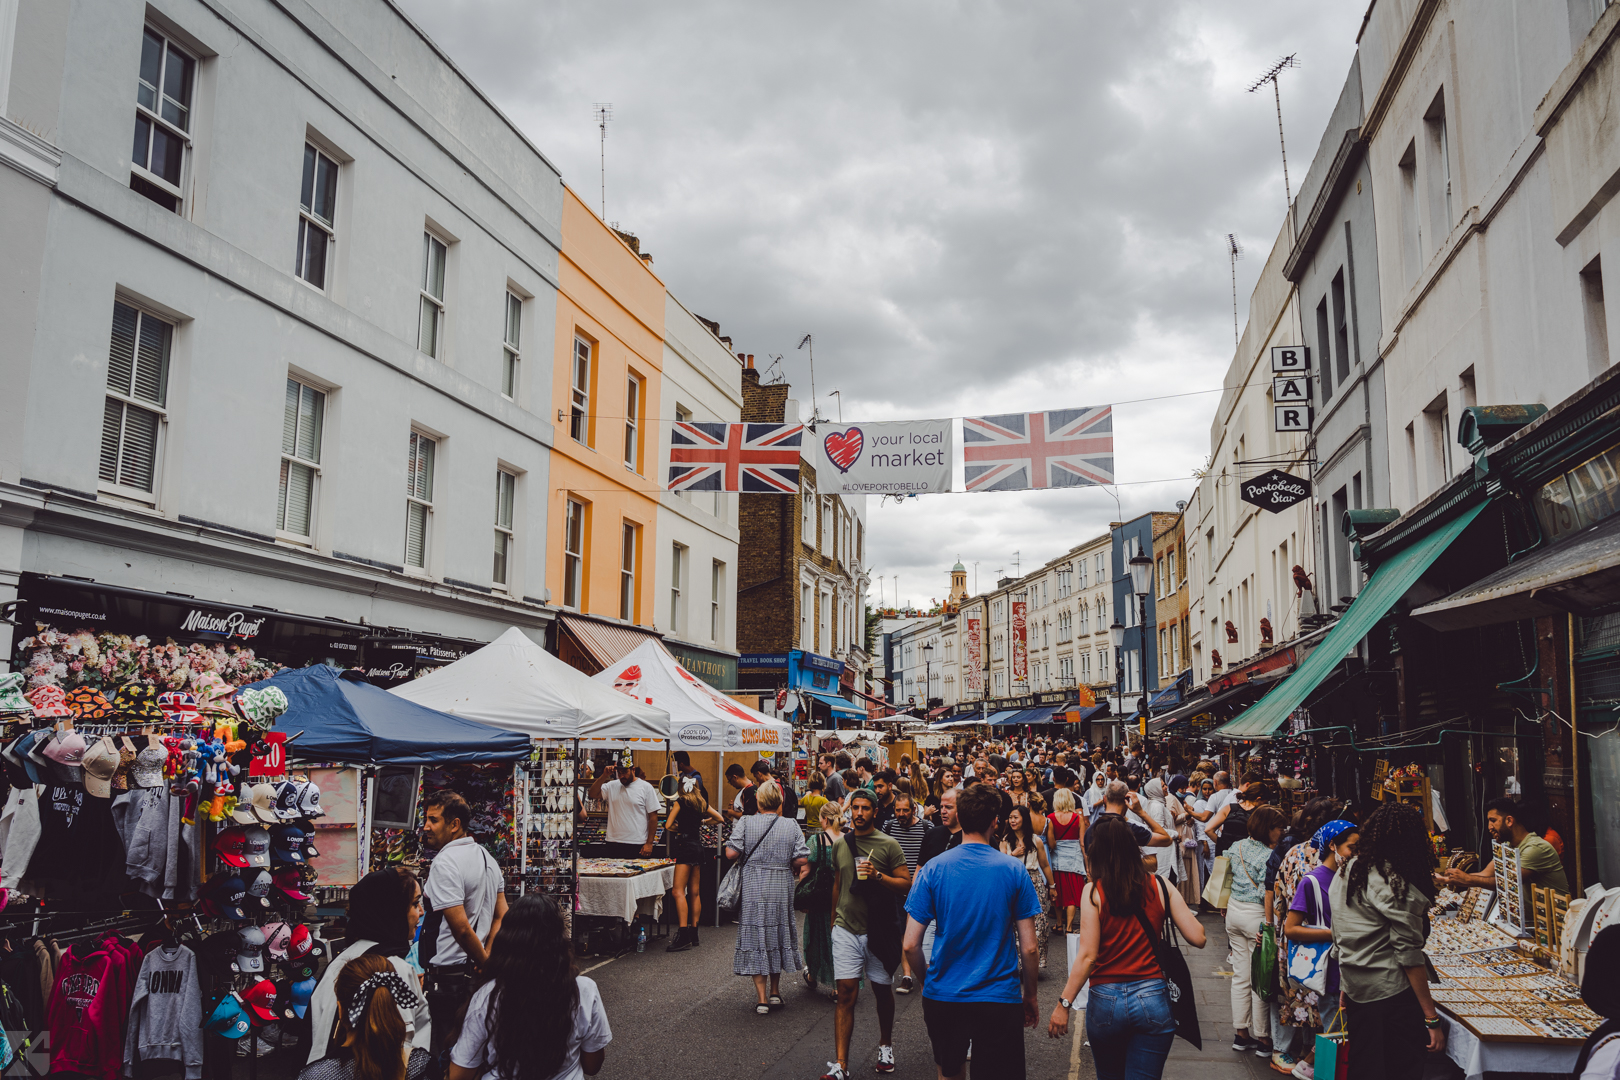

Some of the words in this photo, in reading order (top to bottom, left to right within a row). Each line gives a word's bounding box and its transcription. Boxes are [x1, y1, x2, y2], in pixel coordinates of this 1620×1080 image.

[1281, 350, 1302, 427] BAR
[871, 434, 904, 448] your
[909, 431, 943, 444] local
[871, 449, 944, 467] market
[842, 482, 928, 491] #LOVEPORTOBELLO
[1246, 479, 1305, 498] Portobello
[1271, 491, 1296, 503] Star
[39, 606, 107, 621] www.maisonpuget.co.uk
[179, 609, 227, 632] Maison
[226, 612, 265, 640] Puget
[365, 667, 391, 677] Maison
[741, 728, 779, 744] SUNGLASSES
